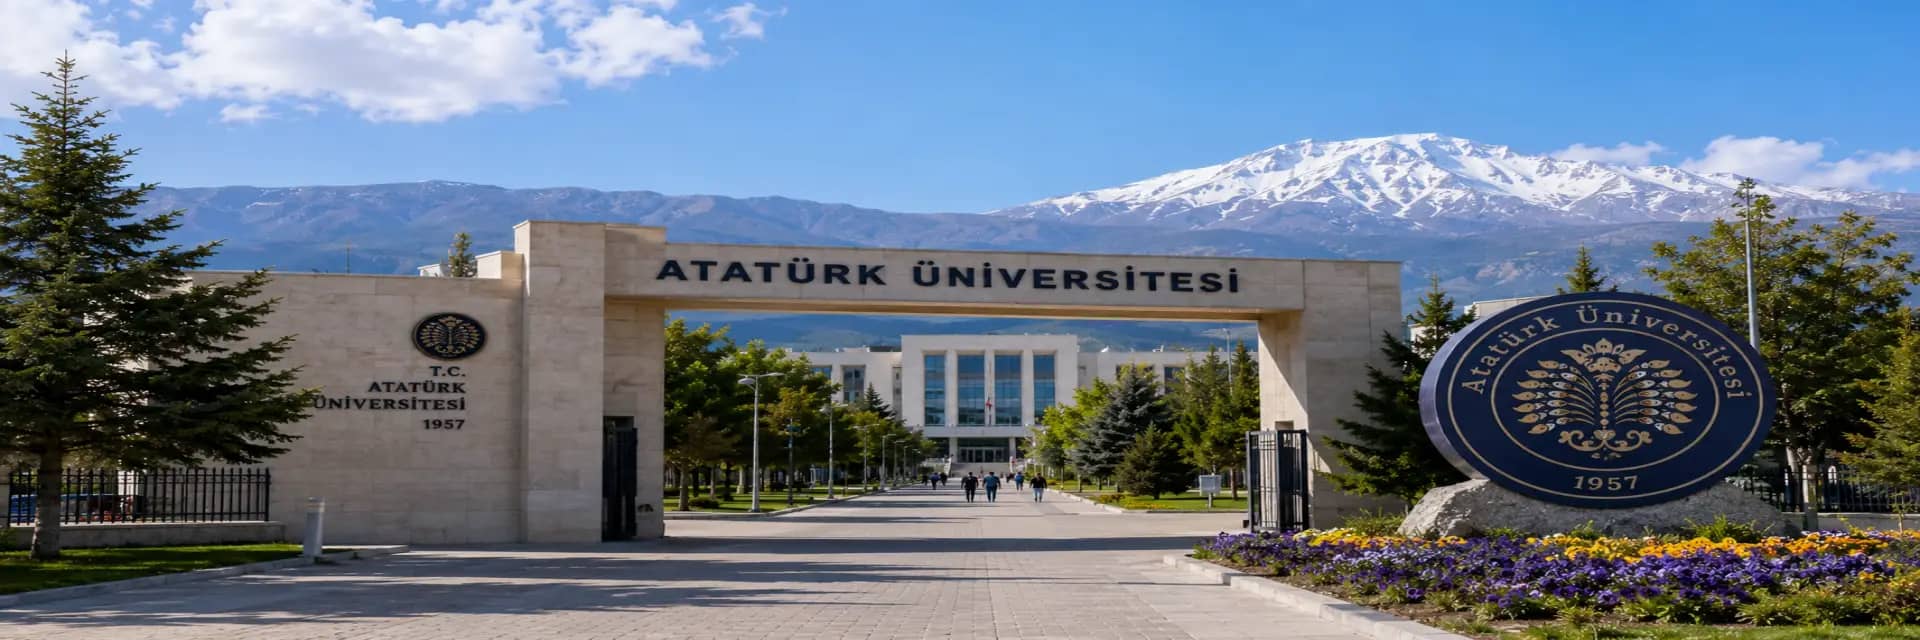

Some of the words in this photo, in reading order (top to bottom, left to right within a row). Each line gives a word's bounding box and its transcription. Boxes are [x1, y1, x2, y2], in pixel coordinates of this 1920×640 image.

[656, 257, 887, 286] ATATÜRK
[912, 260, 1240, 293] ÜNİVERSİTESİ
[1462, 316, 1560, 394] Atatürk
[1576, 305, 1752, 399] Üniversitesi
[430, 366, 466, 377] T.C.
[368, 380, 466, 393] ATATÜRK
[313, 395, 466, 410] ÜNİVERSİTESİ
[423, 419, 465, 430] 1957
[1574, 475, 1639, 490] 1957
